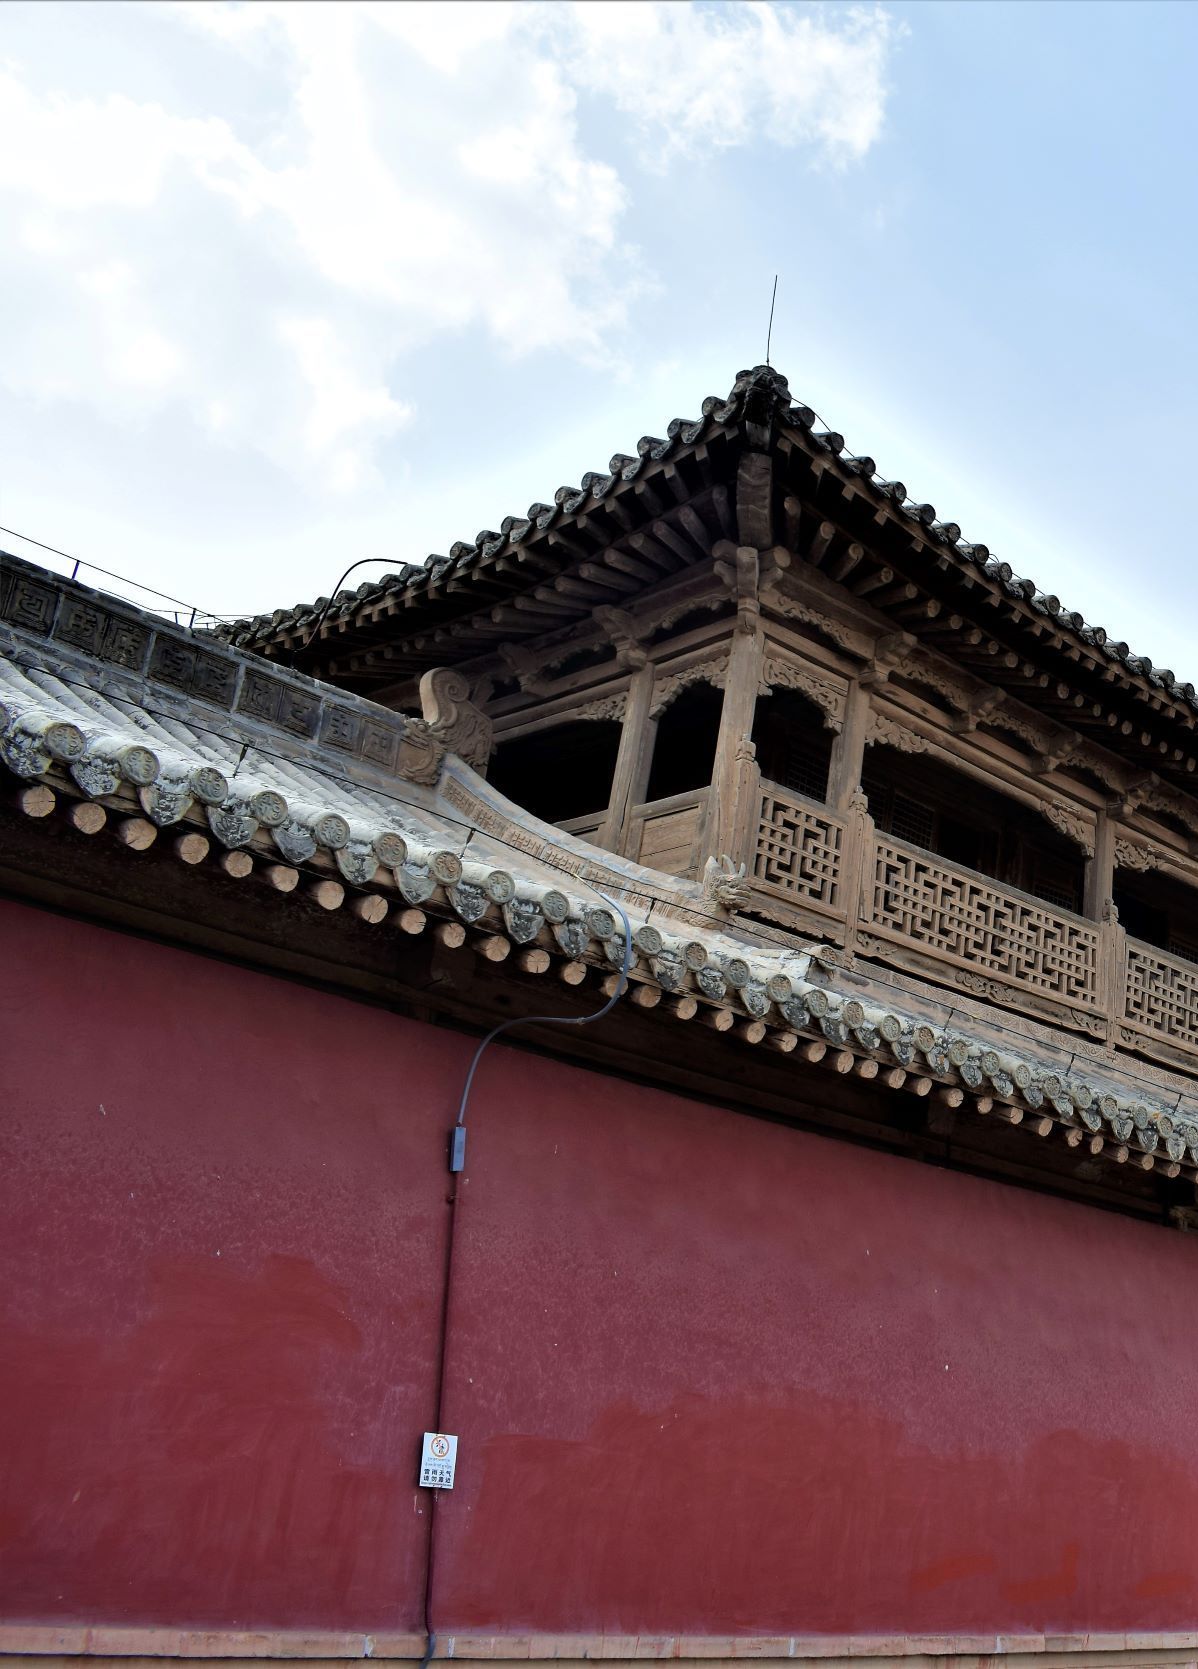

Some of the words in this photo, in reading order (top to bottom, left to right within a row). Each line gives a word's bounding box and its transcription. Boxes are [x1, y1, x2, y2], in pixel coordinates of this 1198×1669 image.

[424, 1468, 452, 1477] 雷雨天气
[423, 1475, 451, 1483] 请勿靠近
